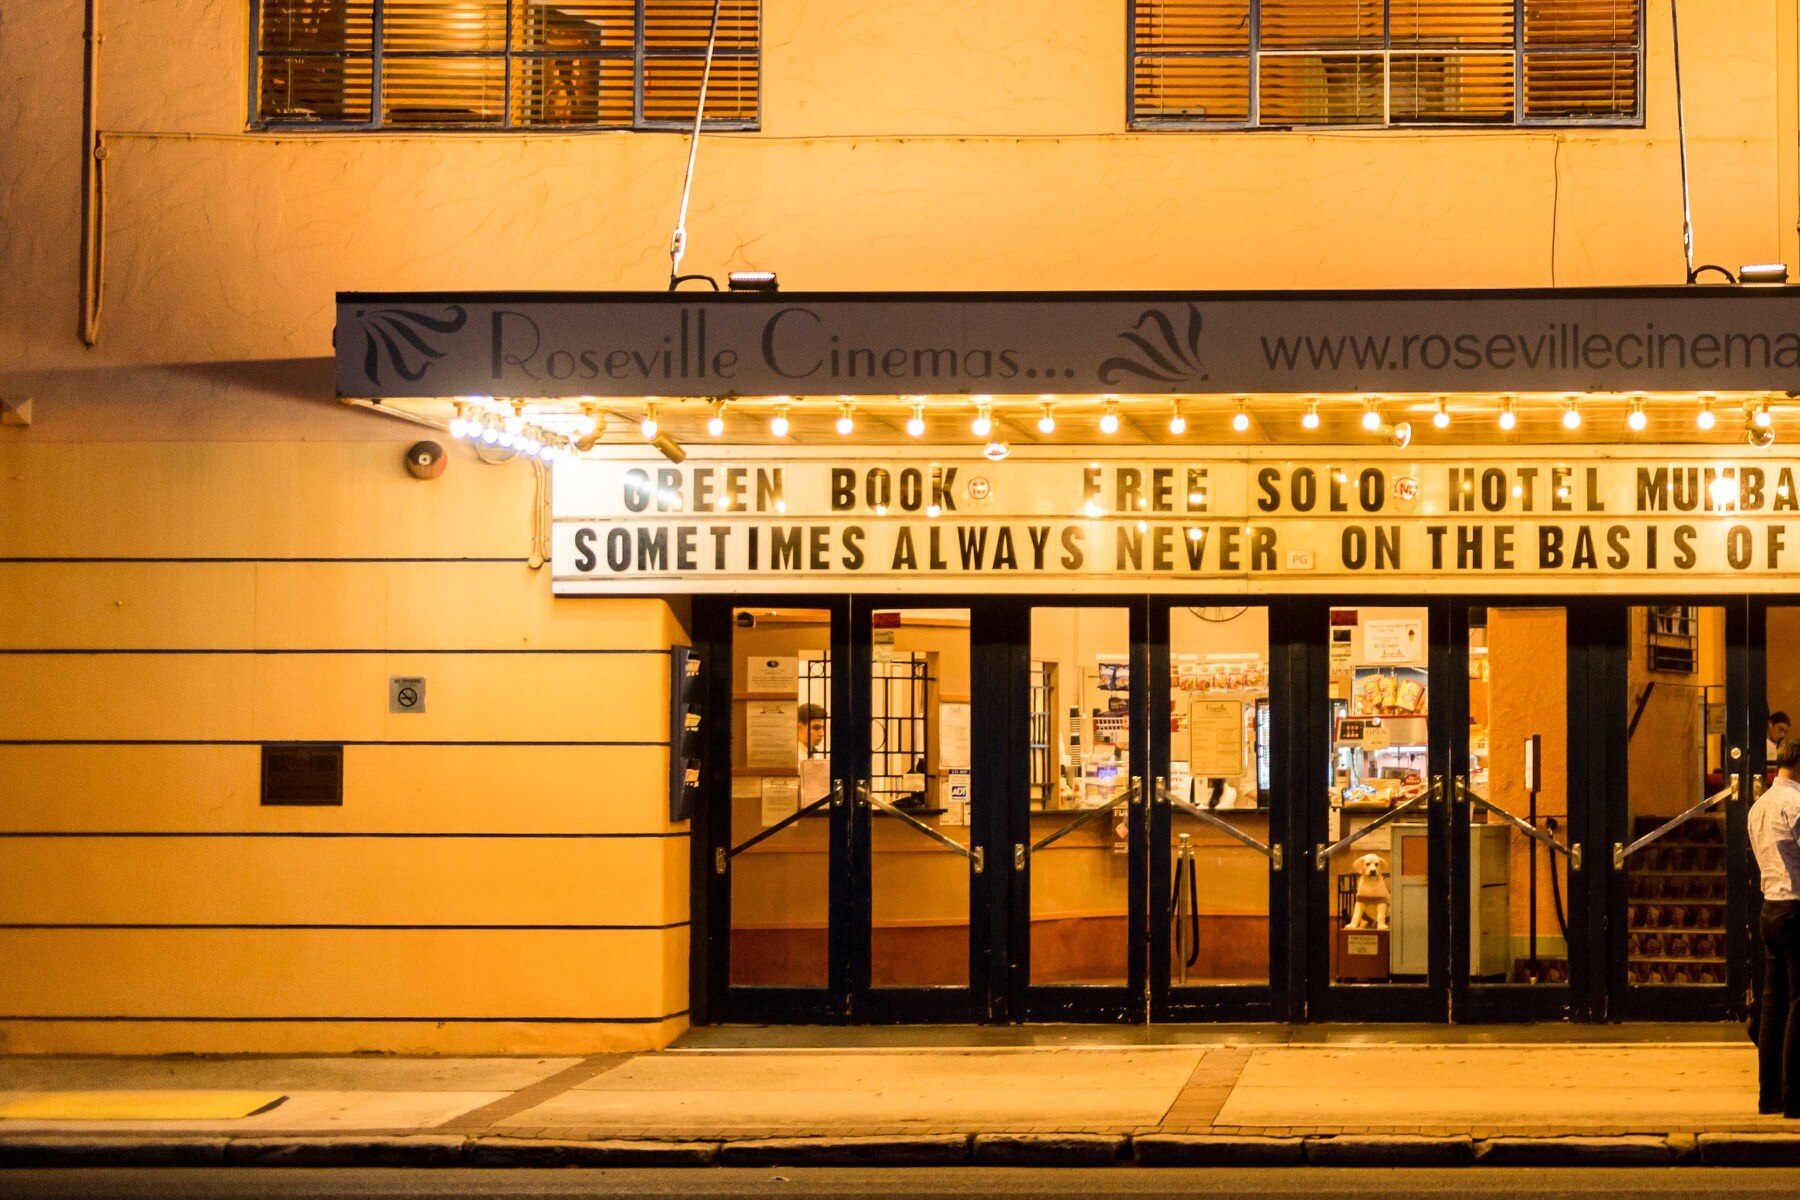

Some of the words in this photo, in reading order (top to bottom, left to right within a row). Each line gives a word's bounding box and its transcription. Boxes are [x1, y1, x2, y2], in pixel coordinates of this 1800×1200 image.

[490, 307, 739, 381] Roseville
[623, 467, 784, 513] GREEN
[831, 467, 959, 512] BOOK
[1083, 467, 1208, 513] FREE
[1257, 467, 1385, 513] SOLO
[1448, 467, 1605, 512] HOTEL
[574, 526, 866, 572] SOMETIMES
[892, 525, 1085, 572] ALWAYS
[1116, 525, 1278, 572] NEVER
[1292, 554, 1308, 565] PG
[1341, 525, 1401, 571] ON
[1426, 525, 1515, 571] THE
[1538, 524, 1697, 571] BASIS
[1726, 525, 1786, 571] OF
